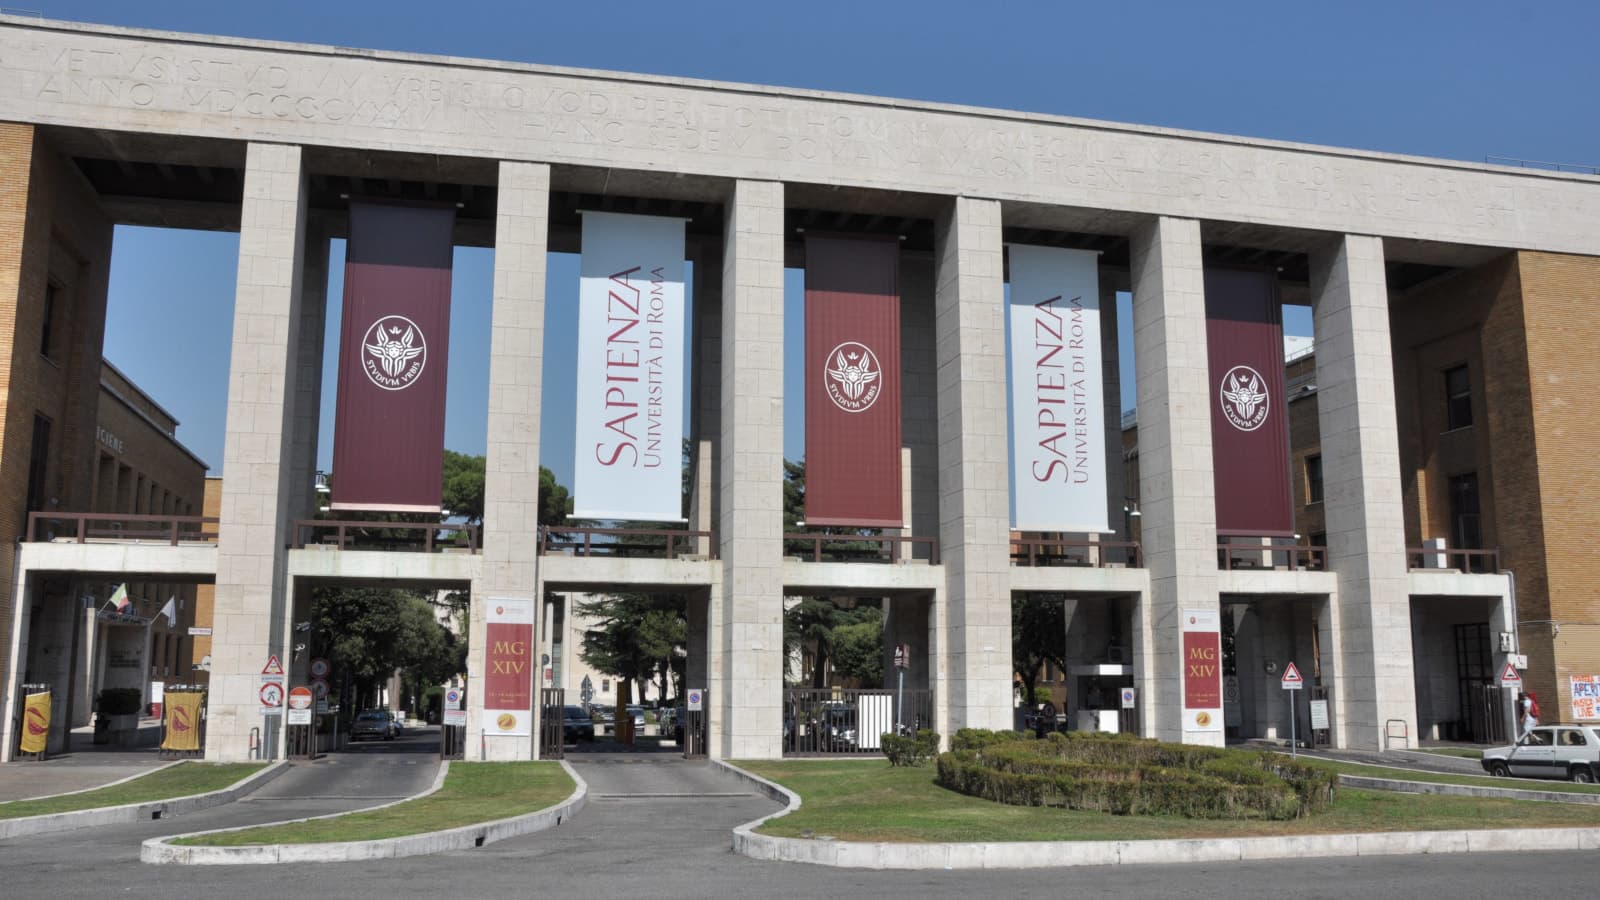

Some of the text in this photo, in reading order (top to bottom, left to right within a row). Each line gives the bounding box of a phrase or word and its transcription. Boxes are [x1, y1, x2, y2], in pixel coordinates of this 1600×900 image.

[37, 75, 154, 108] ANNO
[1069, 296, 1084, 349] ROMA
[595, 266, 641, 467] SAPIENZA
[643, 267, 664, 468] UNIVERSITÀ DI ROMA
[1072, 356, 1085, 373] DI
[1032, 296, 1069, 483] SAPIENZA
[493, 641, 525, 656] MG
[1190, 648, 1214, 660] MG
[491, 660, 525, 675] XIV
[1190, 665, 1216, 678] XIV
